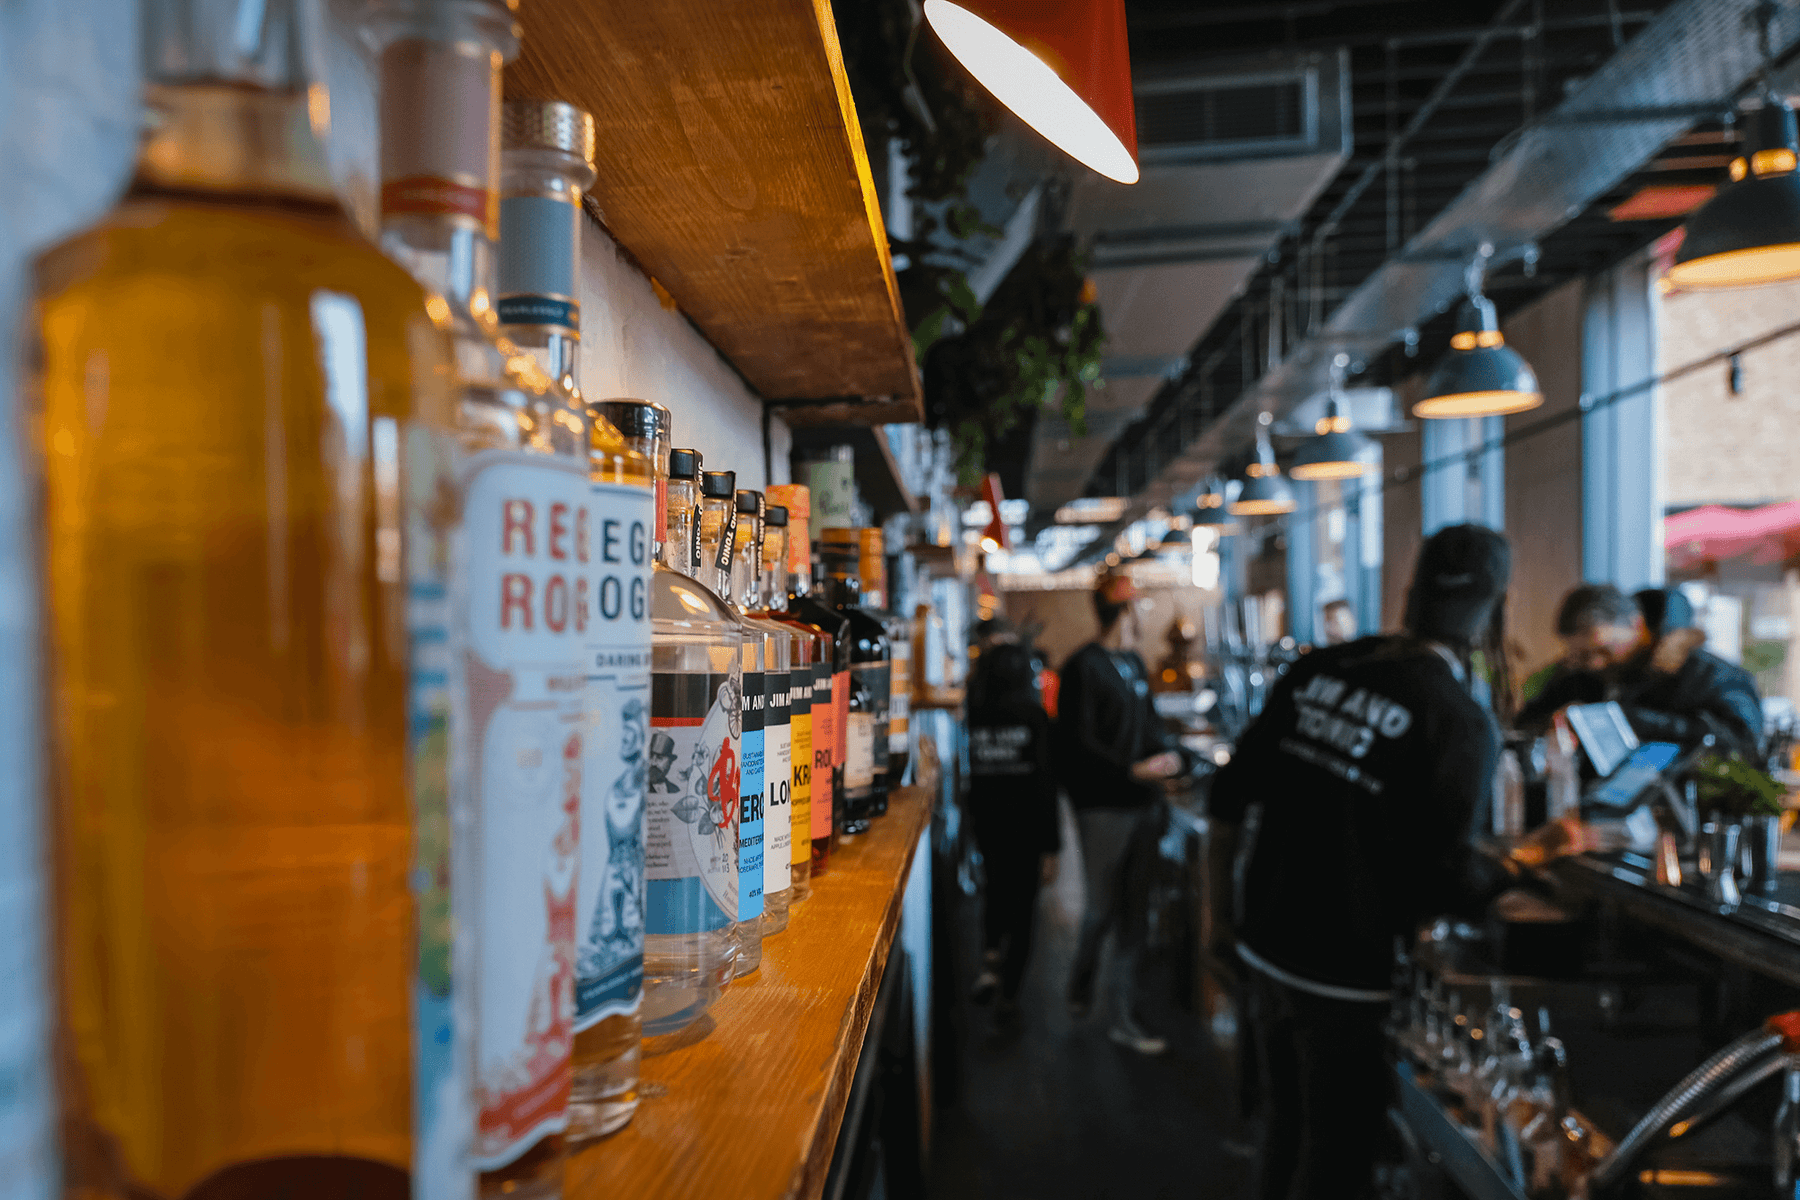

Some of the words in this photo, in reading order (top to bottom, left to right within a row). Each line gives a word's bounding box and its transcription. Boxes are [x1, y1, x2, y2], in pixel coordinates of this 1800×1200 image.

[601, 518, 652, 566] EG
[721, 531, 734, 566] TONIC
[599, 574, 652, 622] OG
[769, 693, 785, 708] JIM
[1340, 688, 1412, 739] AND
